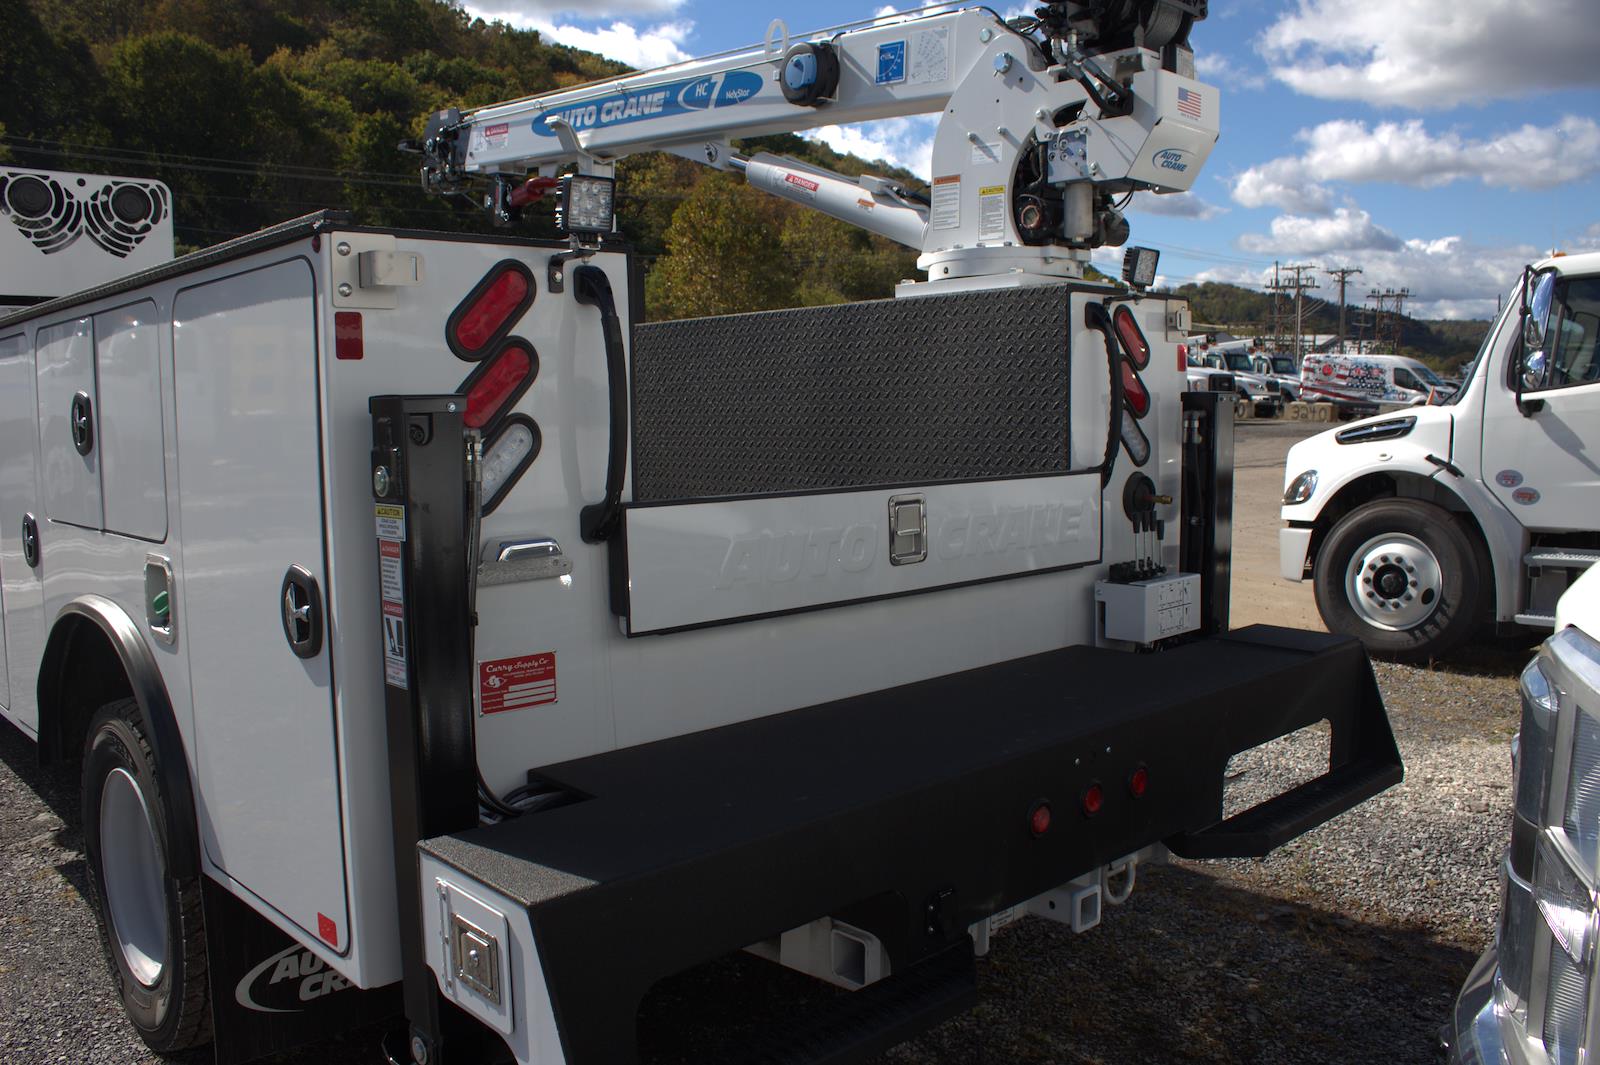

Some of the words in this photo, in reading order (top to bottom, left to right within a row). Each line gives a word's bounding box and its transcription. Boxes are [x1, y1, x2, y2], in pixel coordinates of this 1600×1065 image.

[695, 82, 709, 97] HC
[707, 73, 726, 110] 7
[601, 91, 666, 123] CRANE
[1161, 151, 1182, 162] AUTO
[1161, 160, 1188, 172] CRANE
[793, 177, 816, 190] DANGER
[713, 520, 878, 590] AUTO
[937, 501, 1083, 560] CRANE
